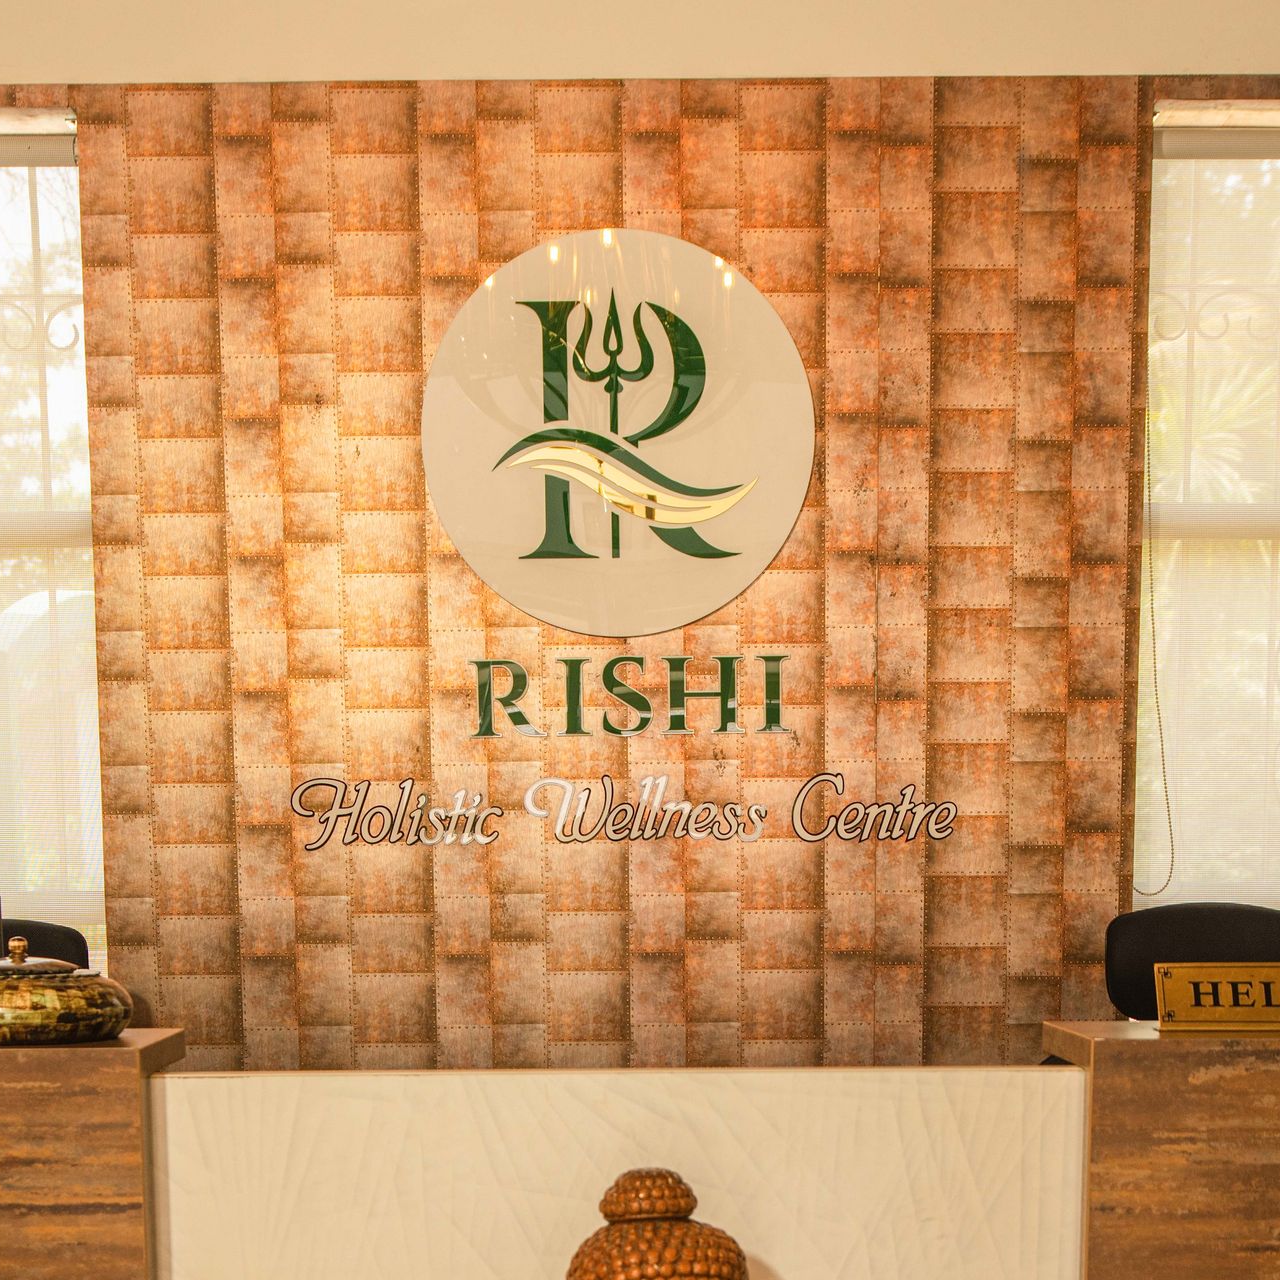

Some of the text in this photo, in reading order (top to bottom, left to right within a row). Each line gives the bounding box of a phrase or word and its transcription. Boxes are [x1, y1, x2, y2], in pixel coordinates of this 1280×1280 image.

[468, 655, 793, 737] RISHI
[290, 773, 957, 851] Holistic Wellness Centre
